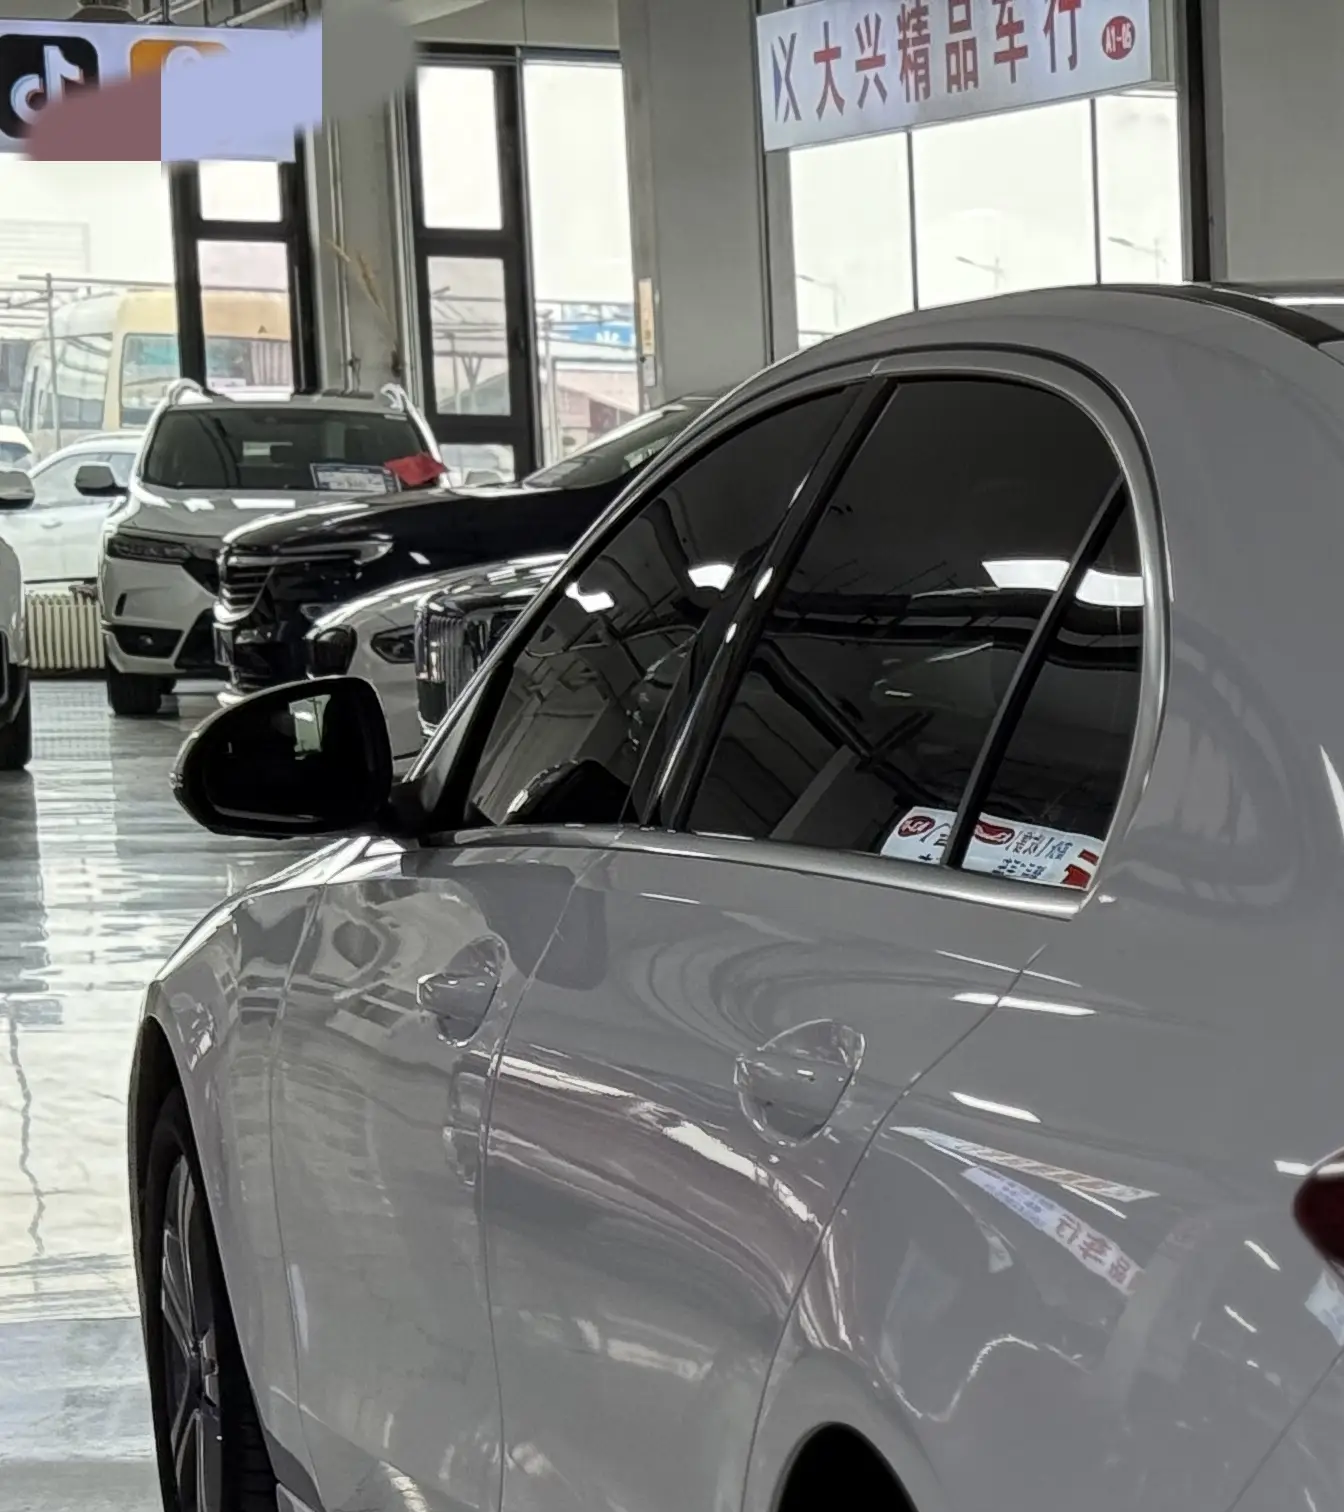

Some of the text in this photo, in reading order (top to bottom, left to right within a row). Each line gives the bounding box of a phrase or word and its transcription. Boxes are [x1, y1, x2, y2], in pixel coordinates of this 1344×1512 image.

[813, 0, 1082, 120] 大兴精品车行
